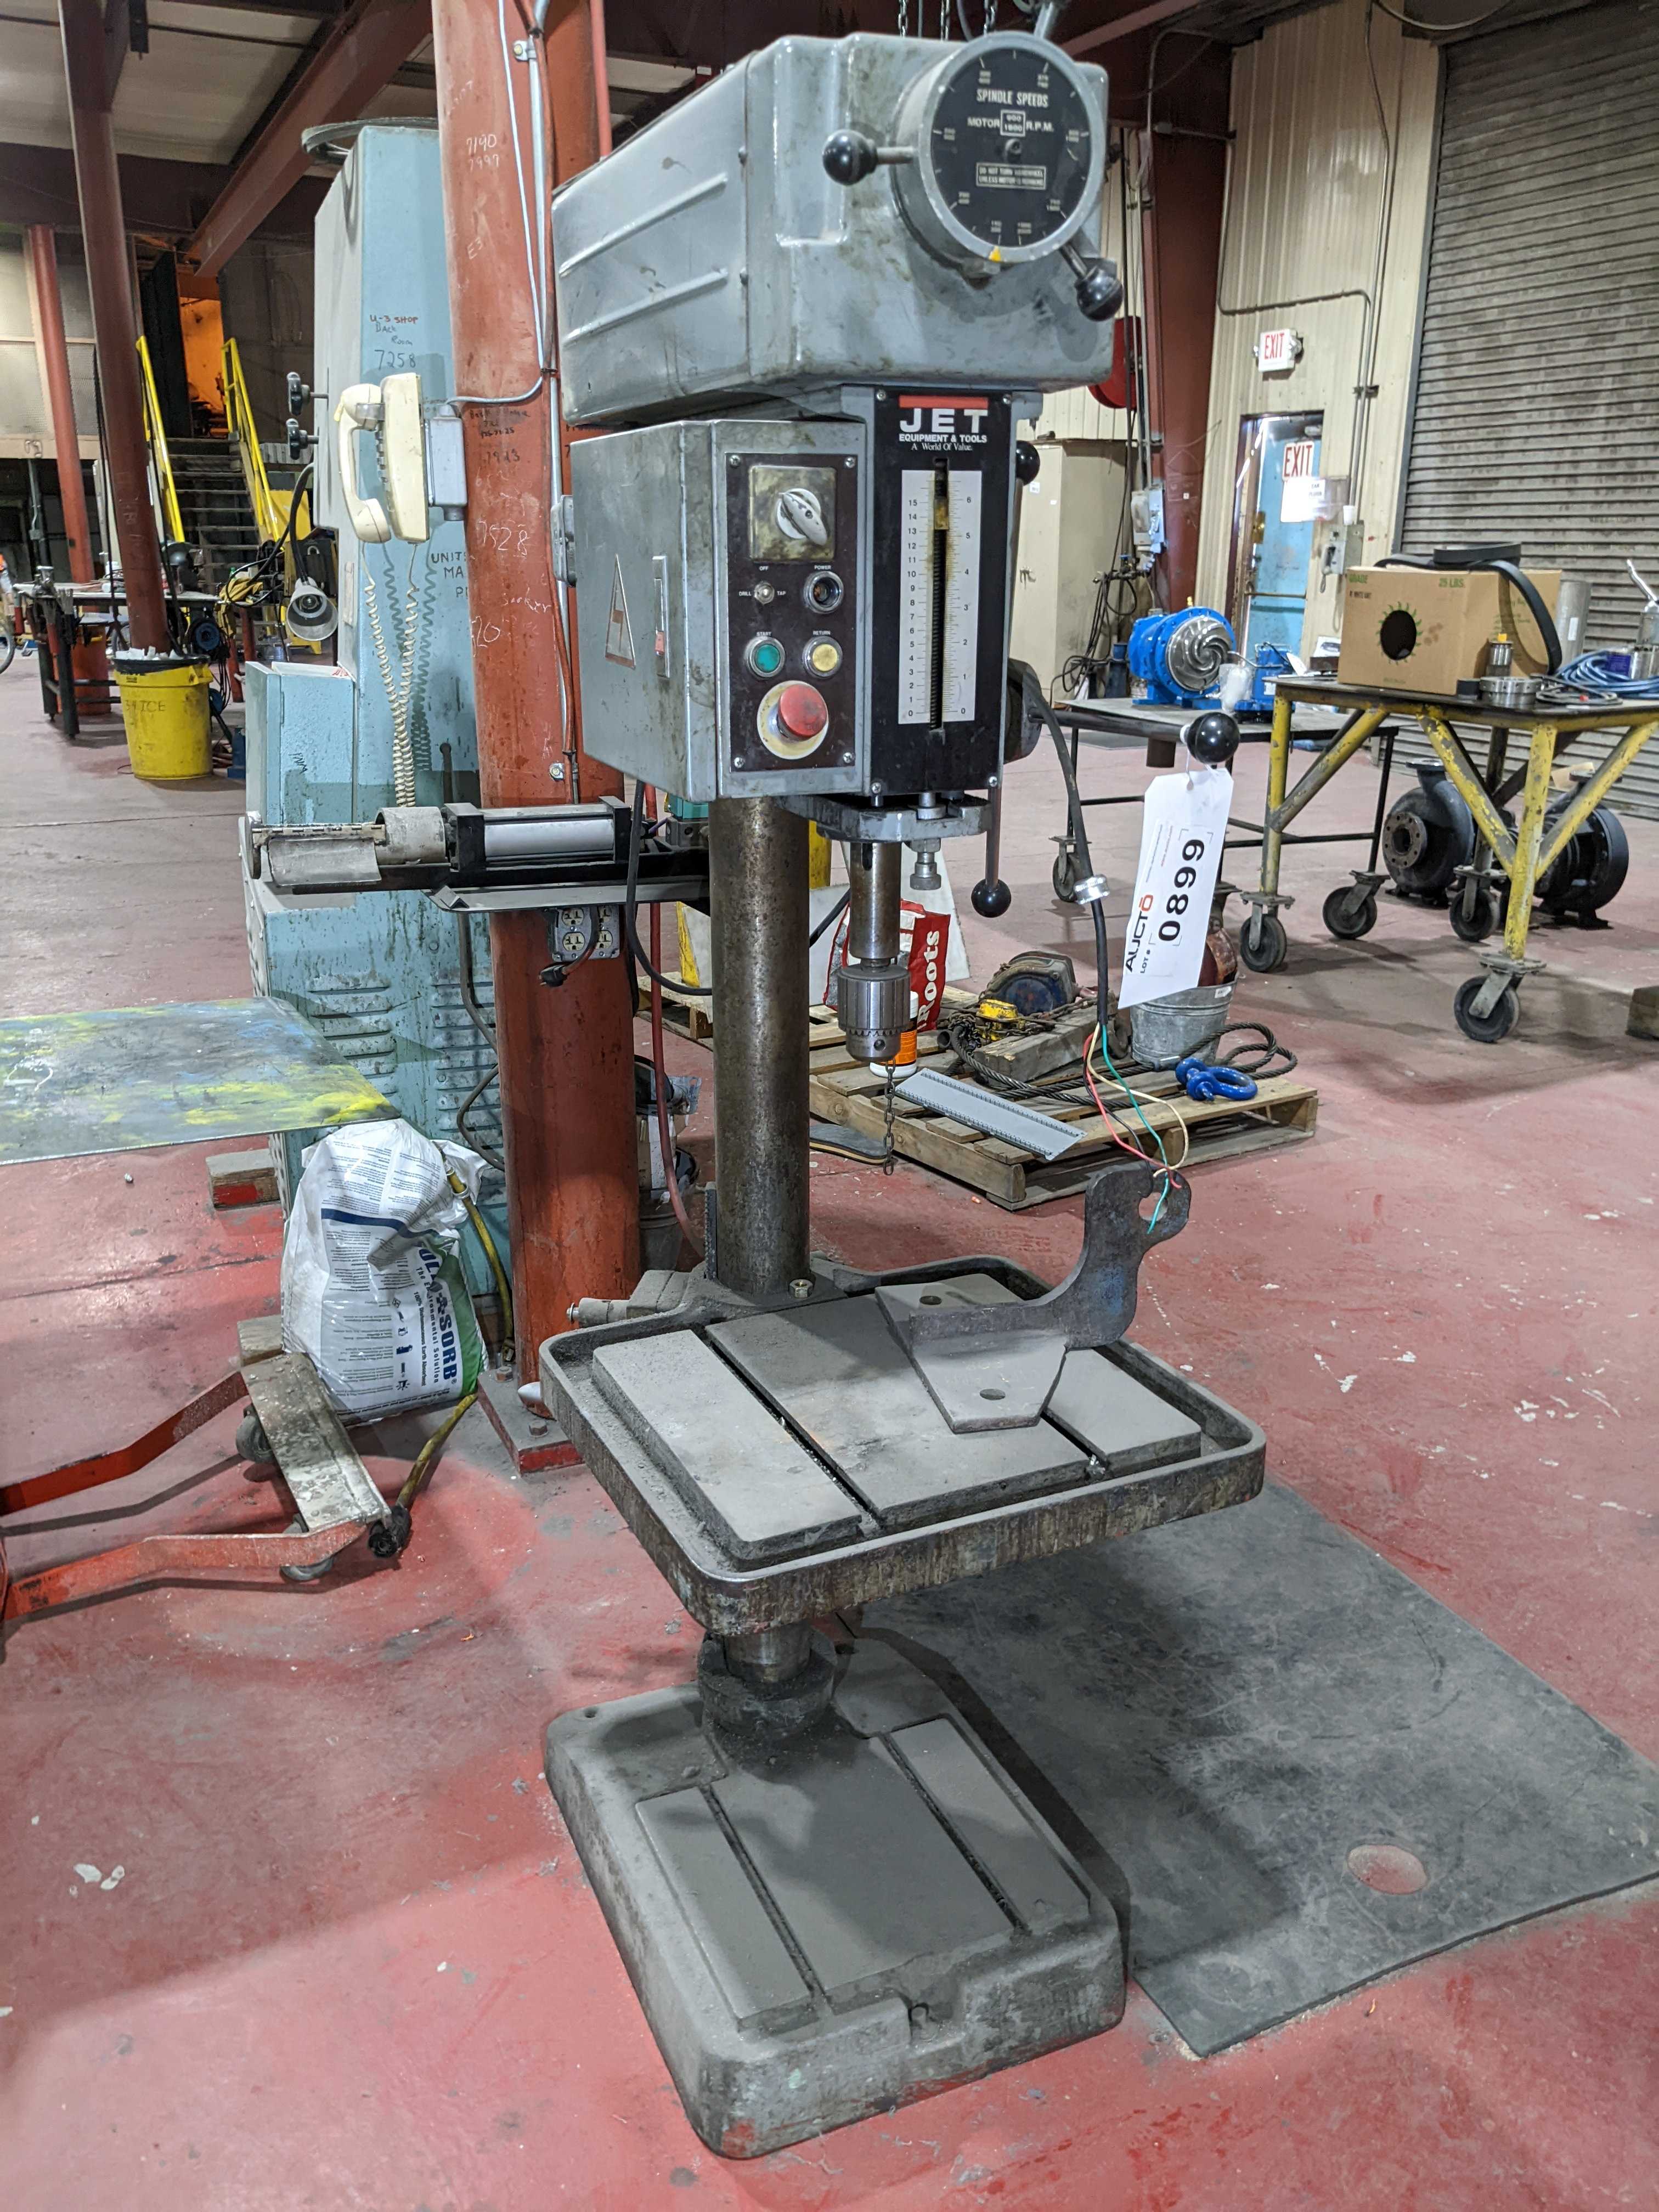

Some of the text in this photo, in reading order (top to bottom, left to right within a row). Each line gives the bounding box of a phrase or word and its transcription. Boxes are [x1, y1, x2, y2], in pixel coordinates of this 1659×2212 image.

[976, 88, 1048, 108] SPINDLE SPEEDS
[967, 116, 1054, 132] MOTOR R.P.M.
[394, 316, 419, 324] SHOP
[1264, 332, 1285, 360] EXIT
[374, 349, 416, 371] 7258
[900, 408, 988, 433] JET
[899, 433, 988, 443] EQUIPMENT & TOOLS
[922, 442, 941, 451] World
[943, 442, 952, 451] Of
[1284, 445, 1313, 477] EXIT
[139, 700, 166, 713] ICE
[1158, 839, 1205, 942] 0899
[1140, 956, 1149, 974] LOT
[415, 1266, 426, 1280] The
[414, 1291, 424, 1307] 100%
